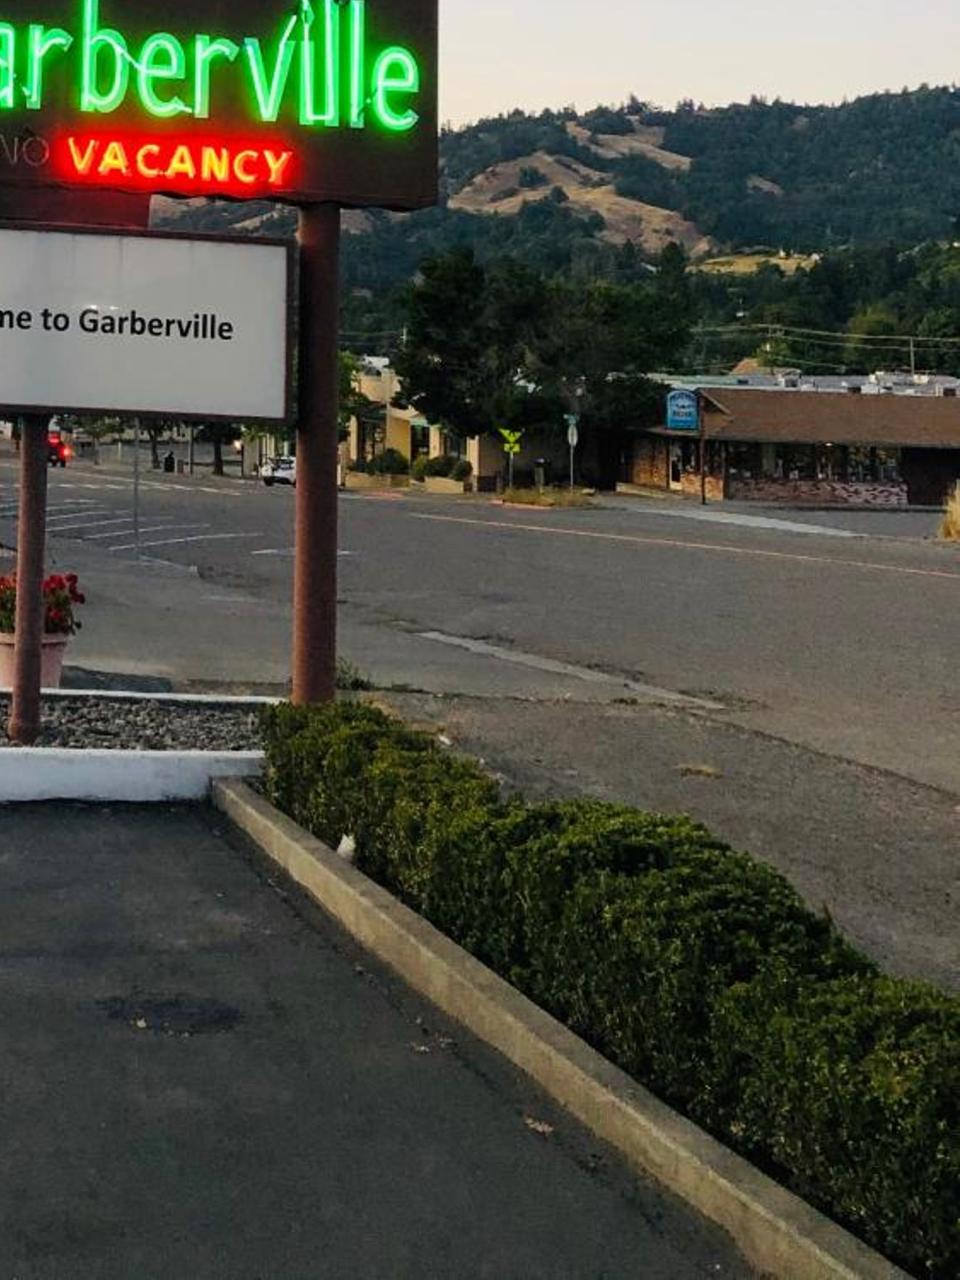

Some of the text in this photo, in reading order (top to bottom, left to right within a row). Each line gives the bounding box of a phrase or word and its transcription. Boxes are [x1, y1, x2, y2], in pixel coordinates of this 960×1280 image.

[68, 135, 292, 184] VACANCY
[41, 307, 70, 332] to
[78, 308, 234, 340] Garberville
